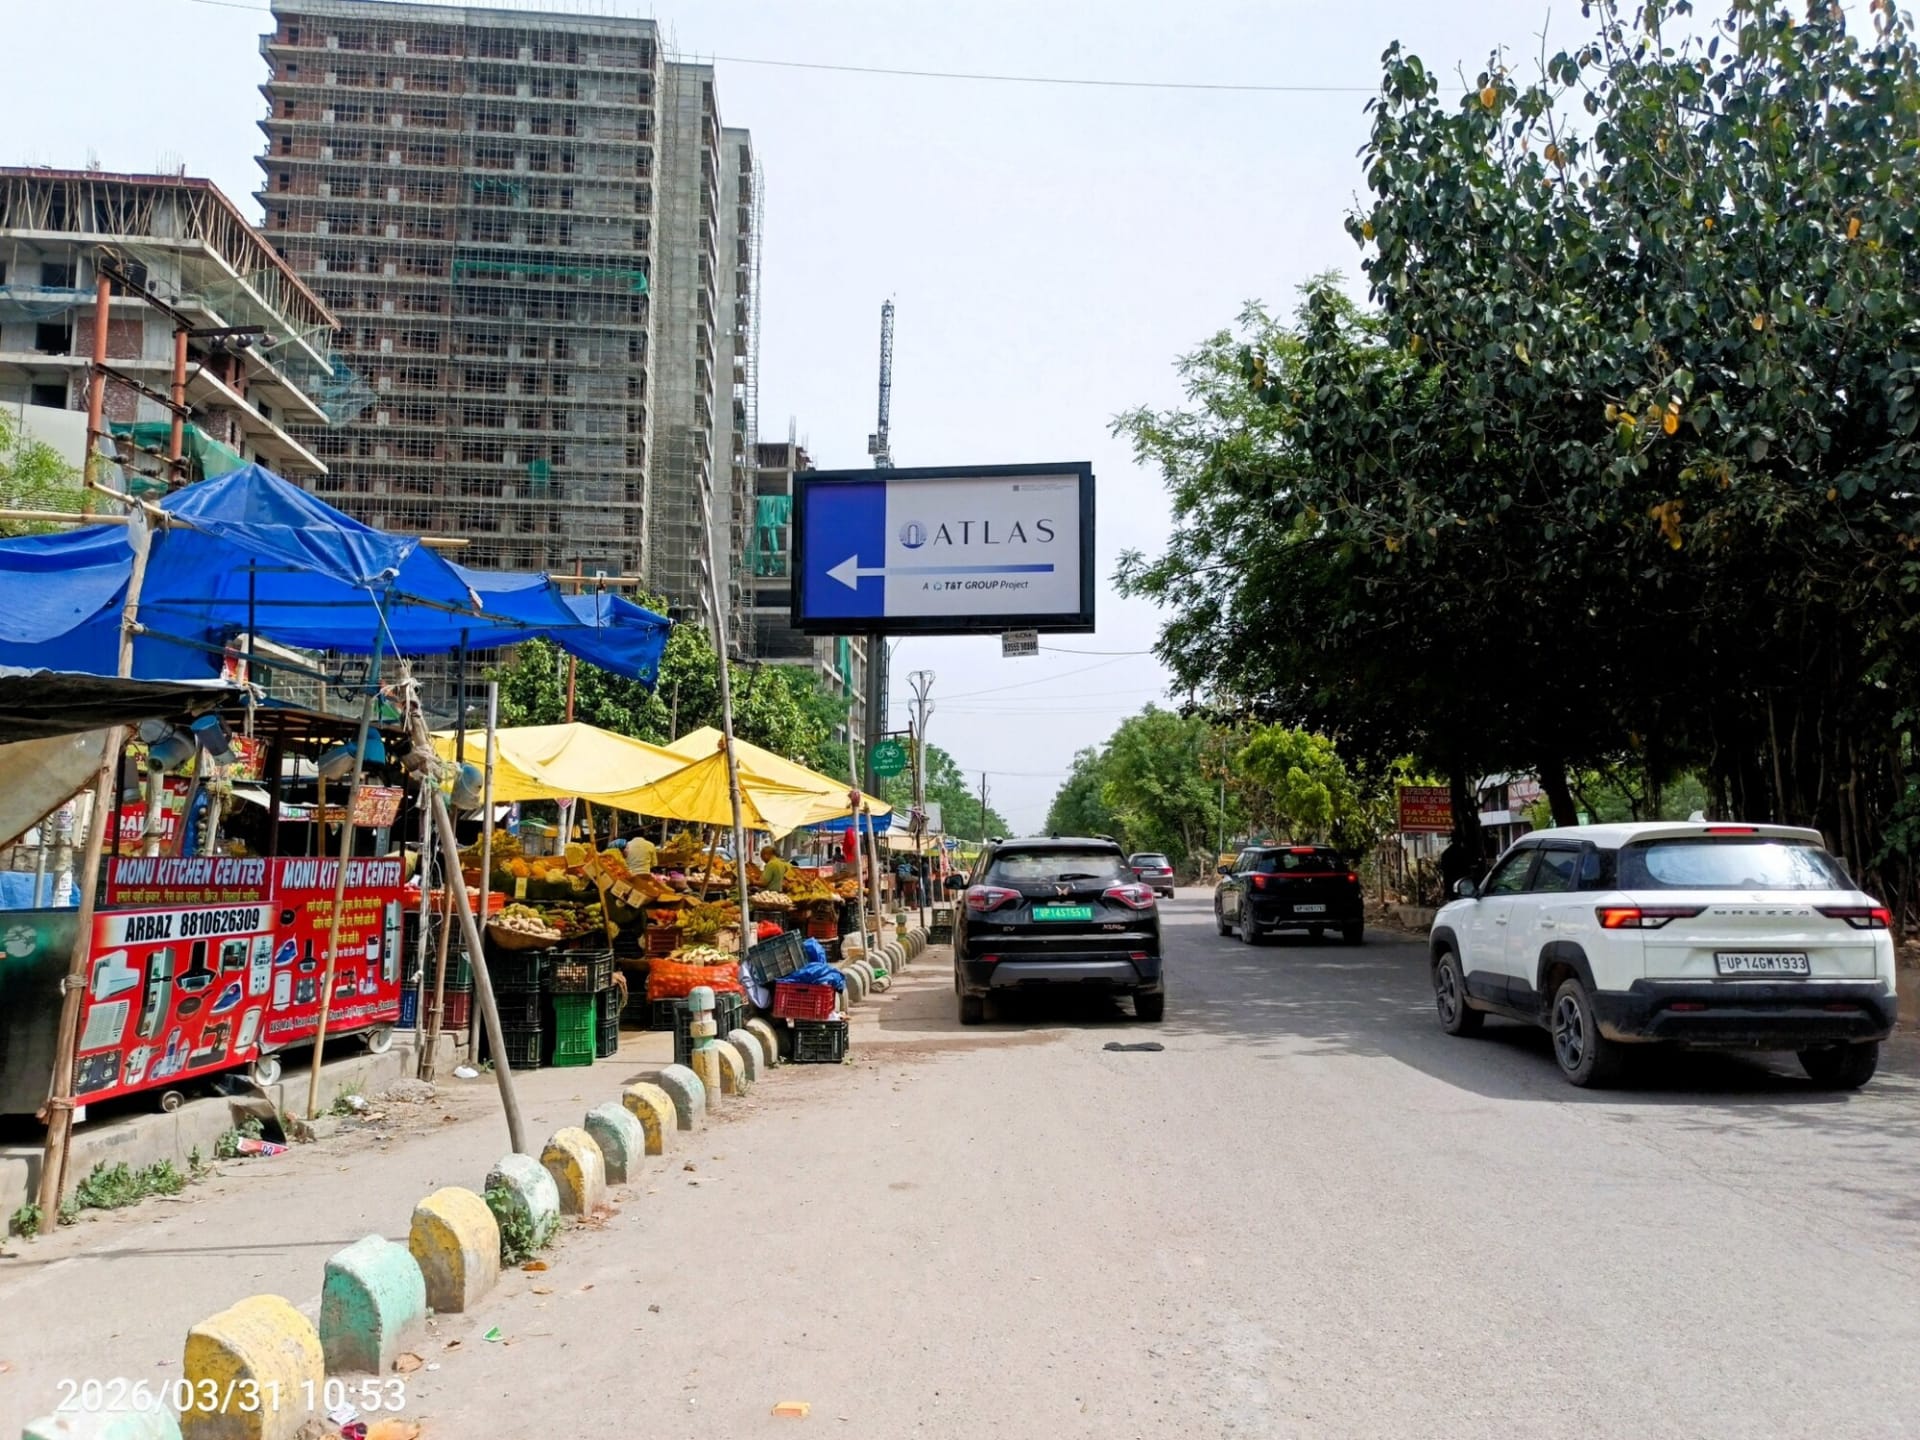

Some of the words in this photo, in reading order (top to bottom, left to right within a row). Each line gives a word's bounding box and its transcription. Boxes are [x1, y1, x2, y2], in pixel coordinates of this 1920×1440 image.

[933, 518, 1055, 546] ATLAS
[922, 582, 929, 591] A
[944, 581, 962, 591] T&T
[965, 581, 999, 590] GROUP
[999, 580, 1029, 591] Project
[1402, 795, 1428, 804] PUBLIC
[114, 858, 156, 885] MONU
[156, 858, 214, 886] KITCHEN
[214, 858, 266, 886] CENTER
[281, 859, 319, 890] MONU
[318, 859, 365, 890] KITHEN
[365, 860, 401, 889] CENTER
[125, 914, 173, 943] ARBAZ
[180, 908, 260, 937] 8810626309
[1726, 956, 1807, 970] UP14GM1933
